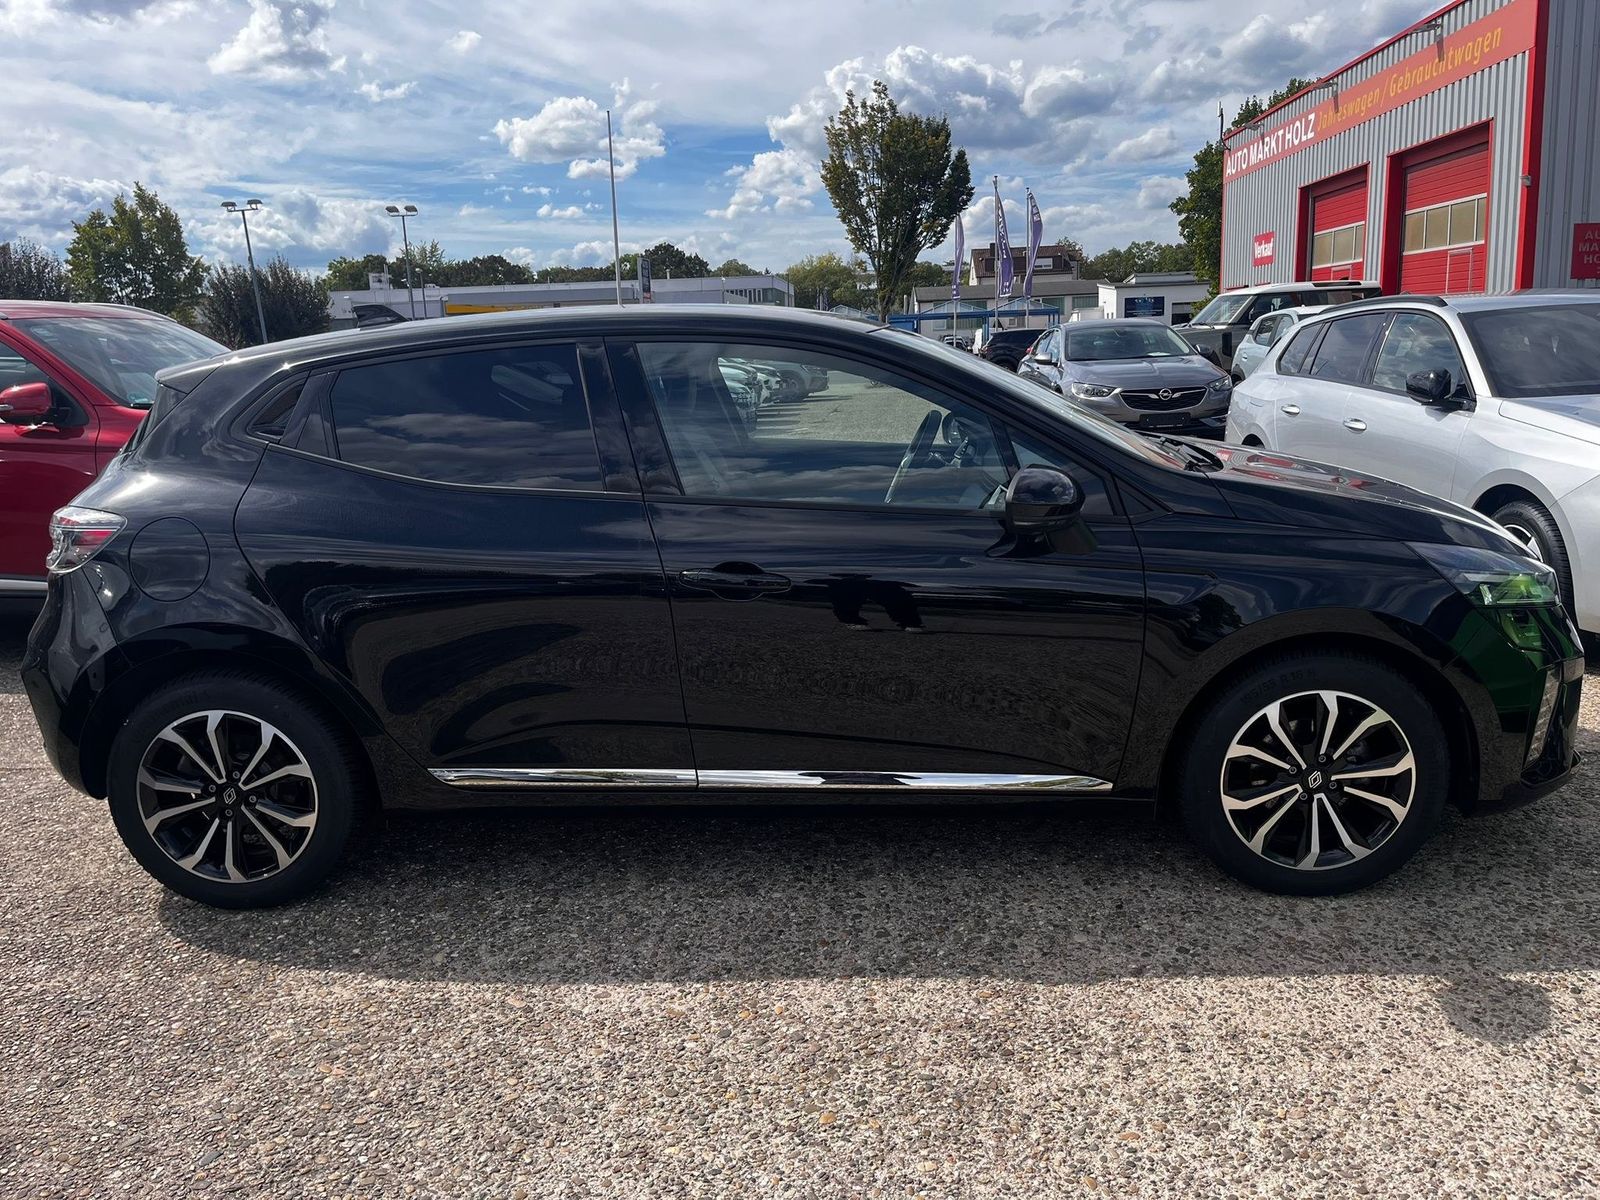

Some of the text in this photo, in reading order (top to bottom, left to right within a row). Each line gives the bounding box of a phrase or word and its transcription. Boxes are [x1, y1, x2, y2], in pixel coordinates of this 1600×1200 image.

[1226, 148, 1249, 177] AUTO
[1249, 129, 1284, 167] MARKT
[1285, 113, 1315, 150] HOLZ
[1317, 88, 1380, 132] Jahreswagen
[1389, 27, 1503, 97] Gebrauchtwagen
[1254, 237, 1274, 259] Verkauf
